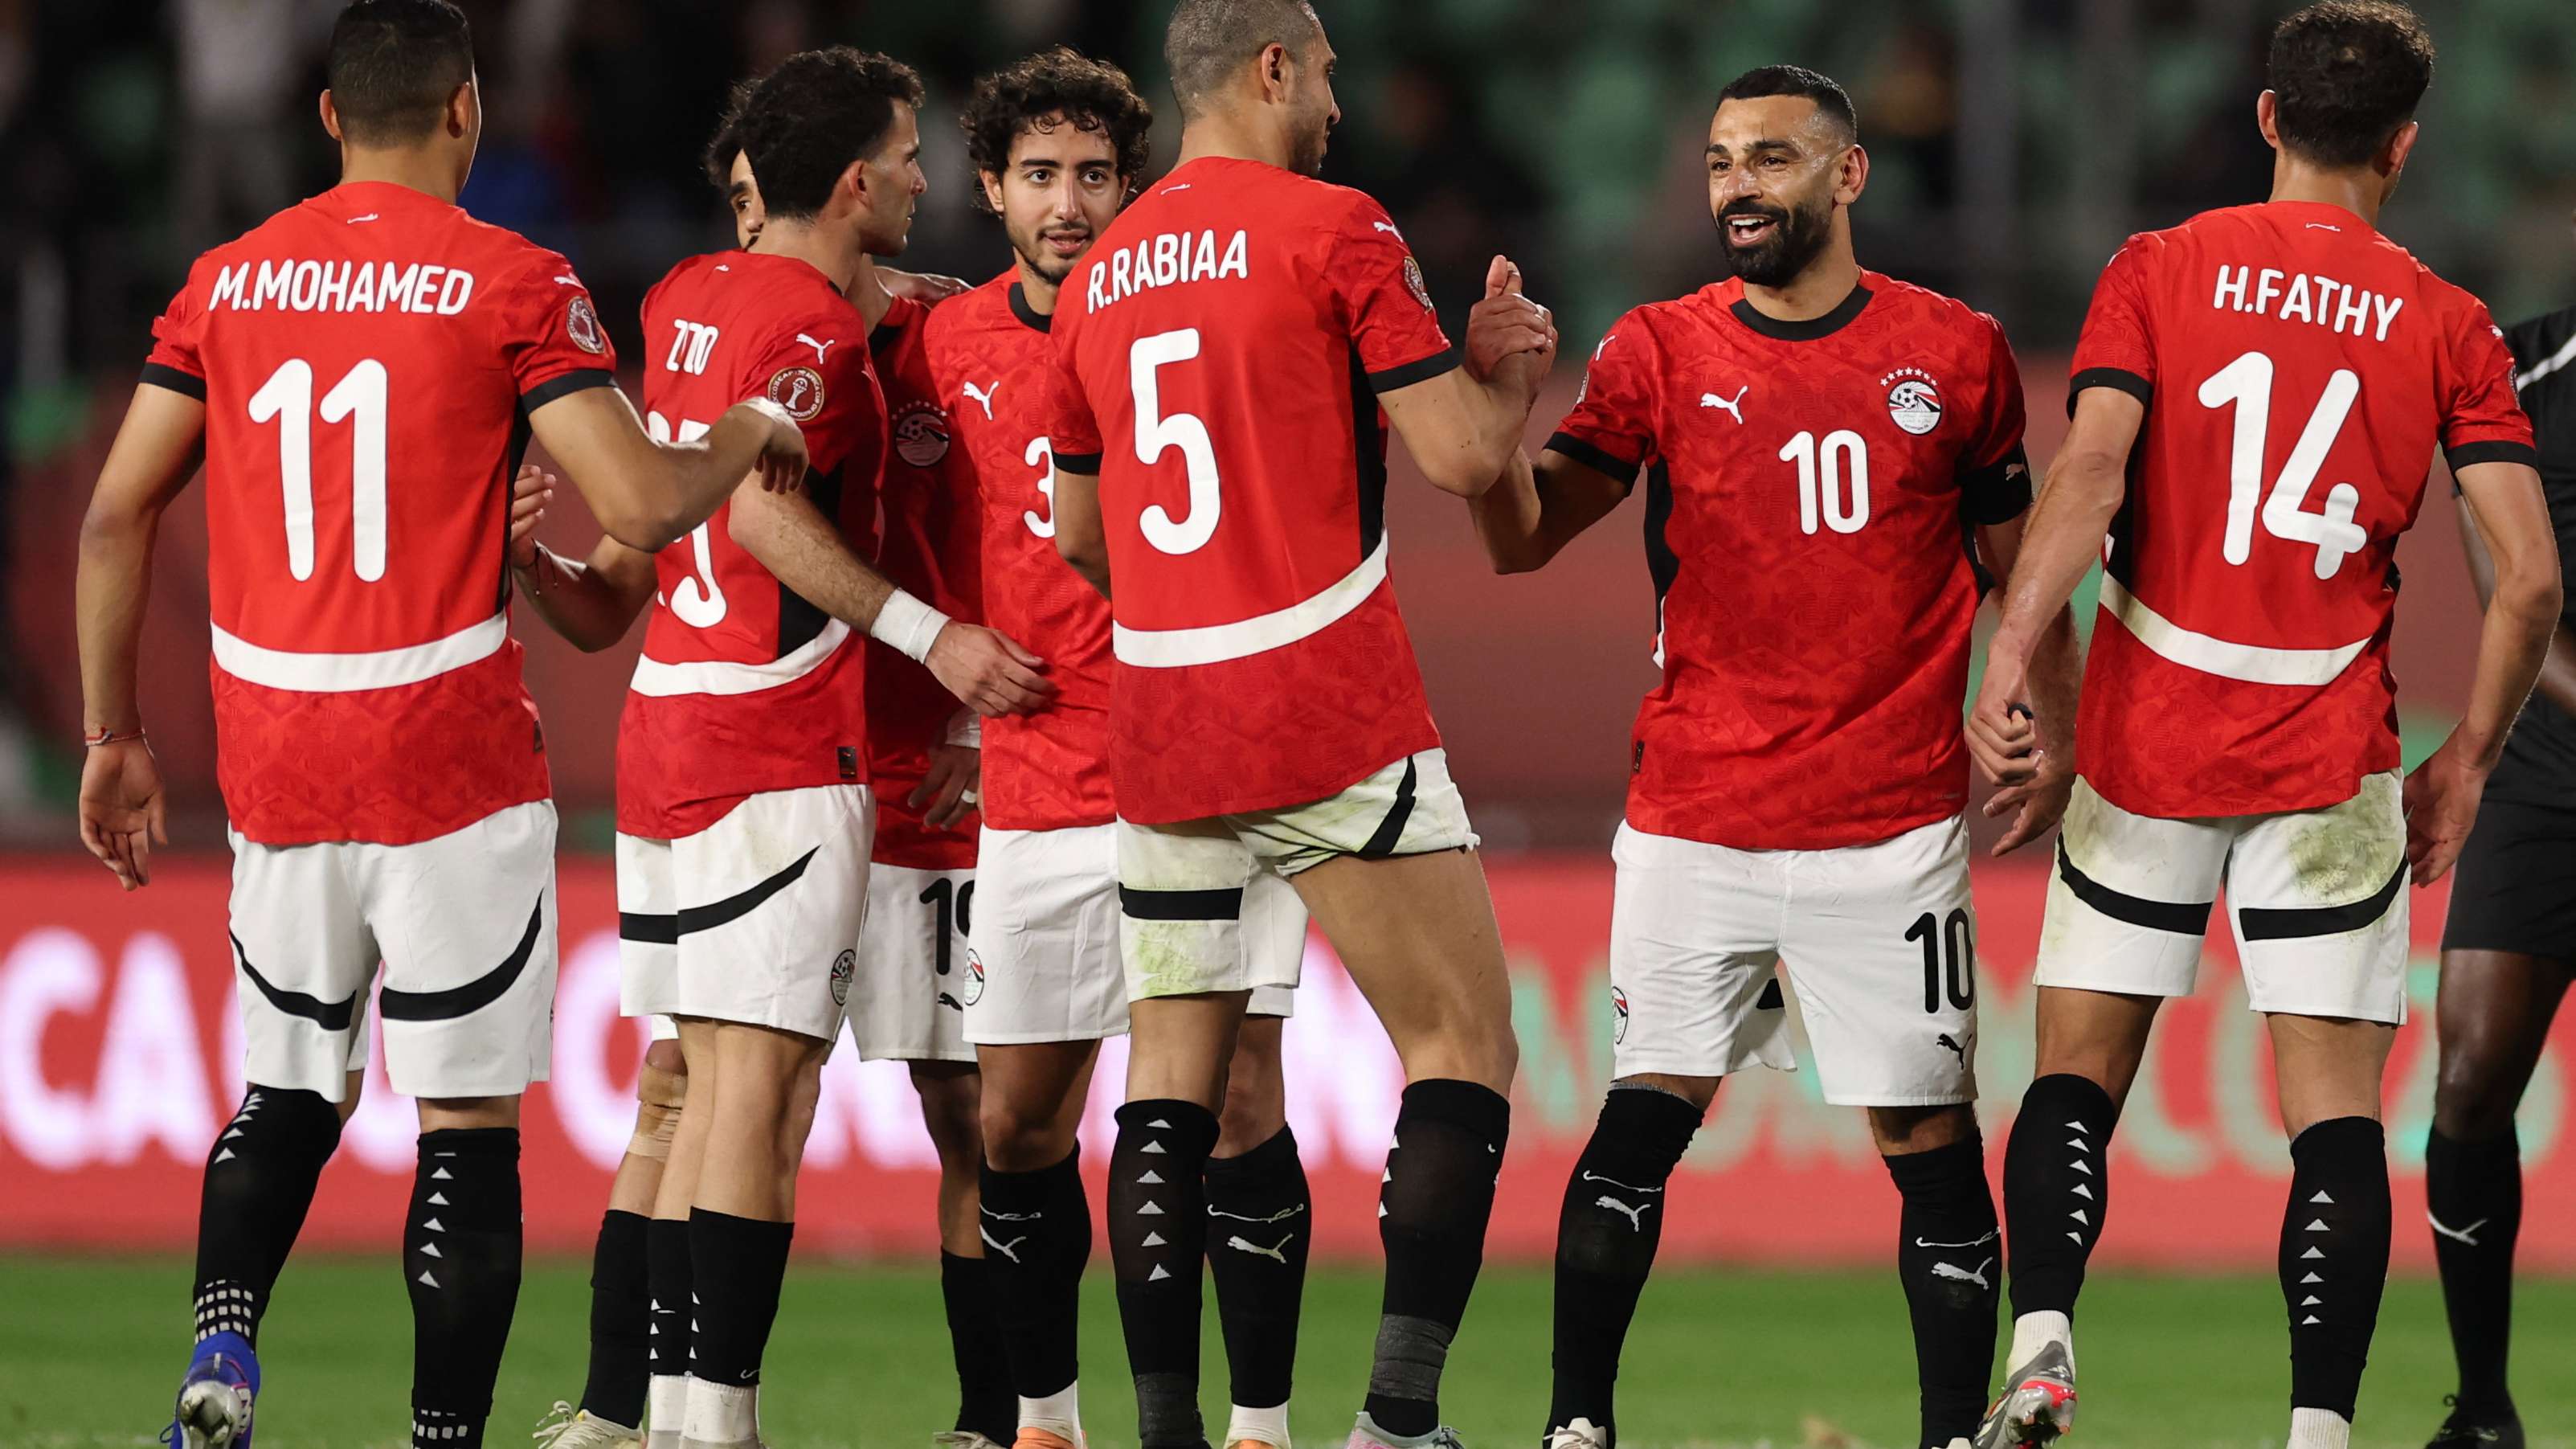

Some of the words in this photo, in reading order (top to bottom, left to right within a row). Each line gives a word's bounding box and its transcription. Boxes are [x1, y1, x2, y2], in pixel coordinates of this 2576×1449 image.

[208, 259, 474, 315] M.MOHAMED
[1087, 229, 1248, 314] R.RABIAA
[2214, 264, 2403, 342] H.FATHY
[248, 358, 387, 582] 11
[1130, 327, 1221, 555] 5
[1779, 429, 1870, 535] 10
[2198, 351, 2367, 579] 14
[1904, 907, 1975, 1014] 10
